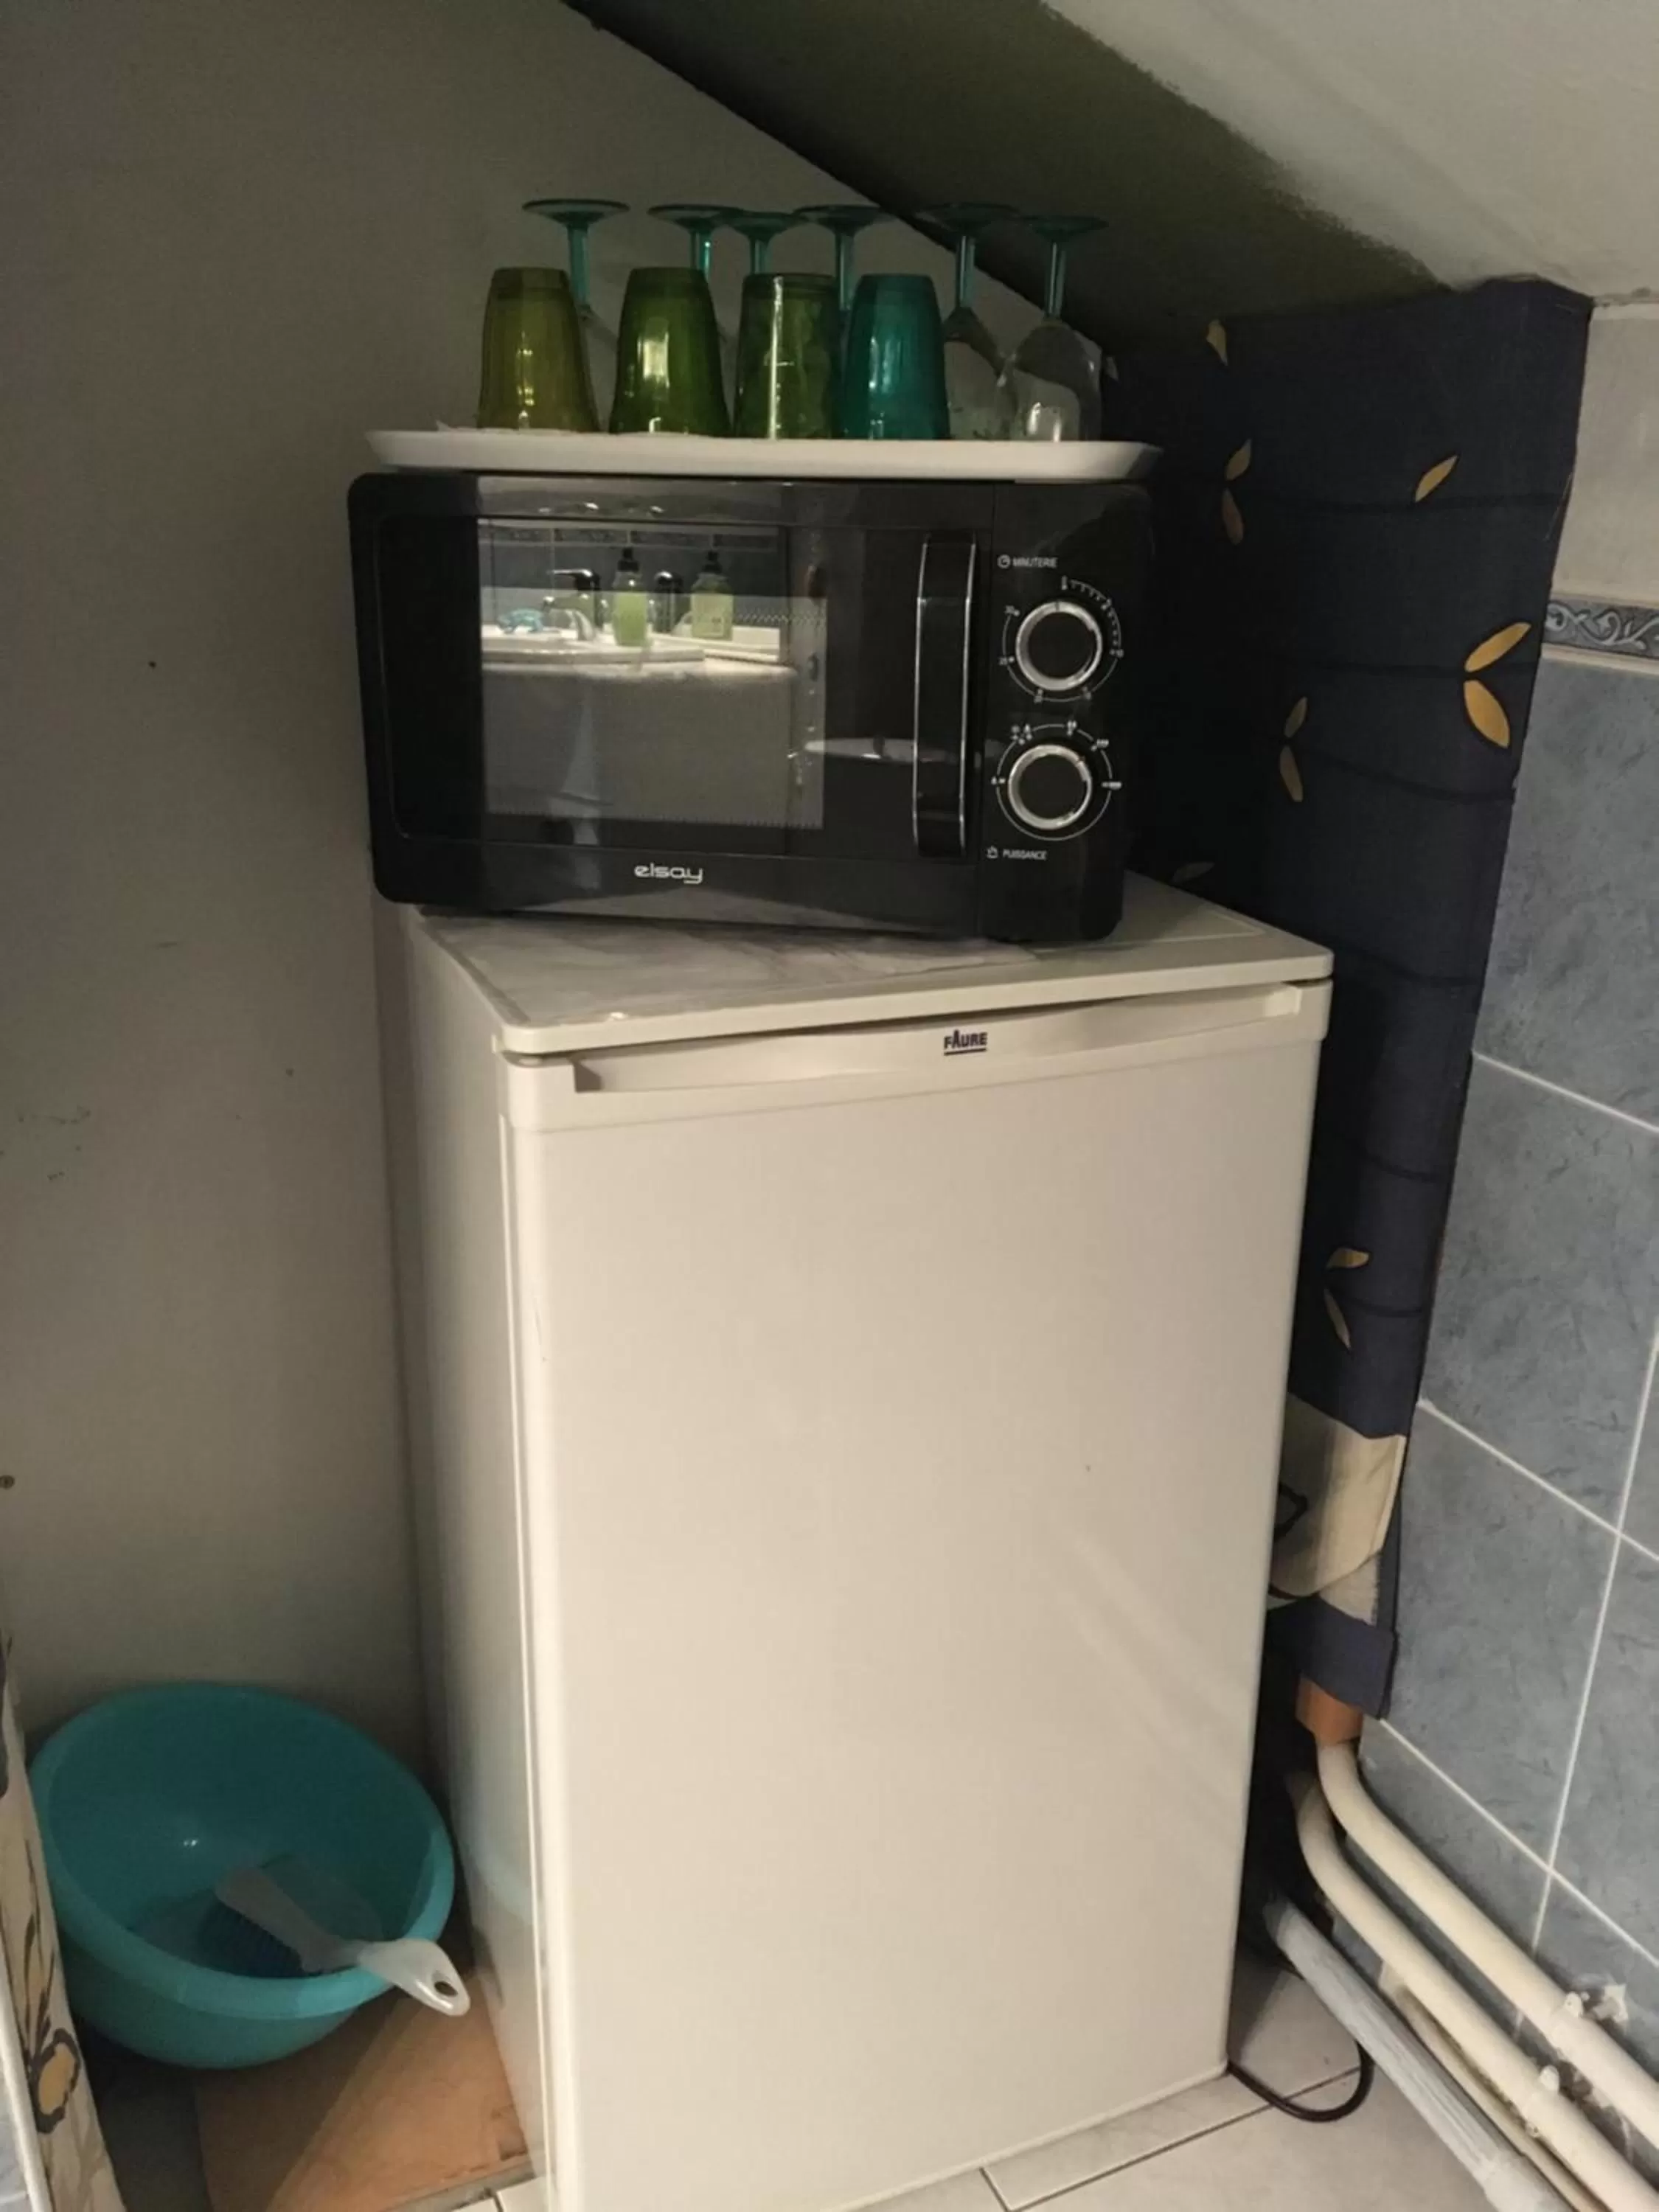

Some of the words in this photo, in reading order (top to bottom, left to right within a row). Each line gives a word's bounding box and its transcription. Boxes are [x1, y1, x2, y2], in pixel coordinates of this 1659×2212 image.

[1003, 849, 1047, 860] PUISSANCE
[634, 862, 703, 884] elsay
[943, 1029, 988, 1049] FAURE
